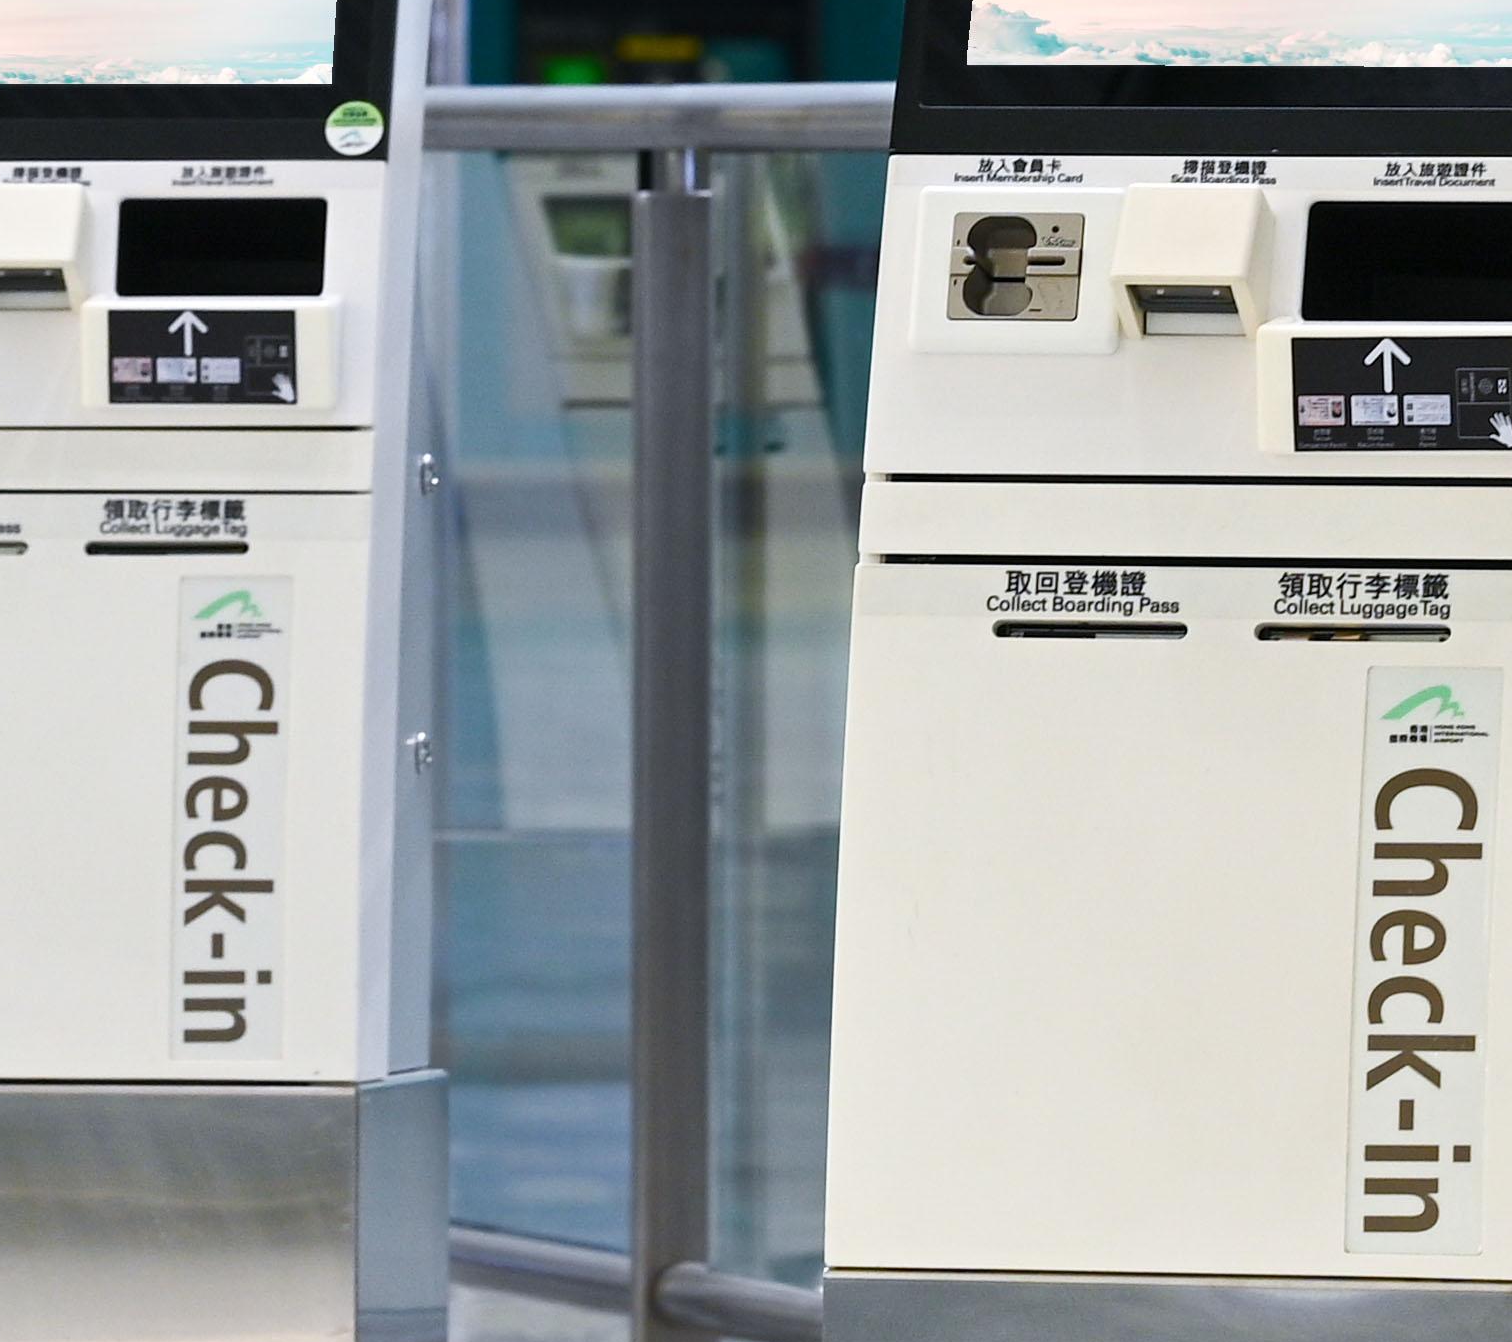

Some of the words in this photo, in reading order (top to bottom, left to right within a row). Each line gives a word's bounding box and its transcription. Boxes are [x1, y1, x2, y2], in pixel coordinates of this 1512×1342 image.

[978, 158, 1061, 173] 放入會員卡
[1385, 162, 1486, 177] 放入旅遊證件
[953, 172, 985, 184] Insert
[985, 172, 1056, 186] Membership
[1056, 172, 1084, 184] Card
[1170, 174, 1198, 185] Scan
[1199, 174, 1250, 185] Boarding
[1251, 174, 1277, 186] Pass
[1372, 176, 1404, 187] Insert
[1403, 176, 1437, 187] Travel
[1438, 176, 1496, 188] Document
[1005, 570, 1147, 596] 取回登機證
[1278, 572, 1449, 599] 領取行李標籤
[986, 596, 1048, 613] Collect
[1052, 596, 1135, 616] Boarding
[1138, 597, 1180, 614] Pass
[1274, 599, 1336, 616] Collect
[1339, 599, 1418, 619] Luggage
[1419, 600, 1451, 620] Tag
[183, 659, 278, 1043] Check-in
[1363, 768, 1483, 1232] Check-in
